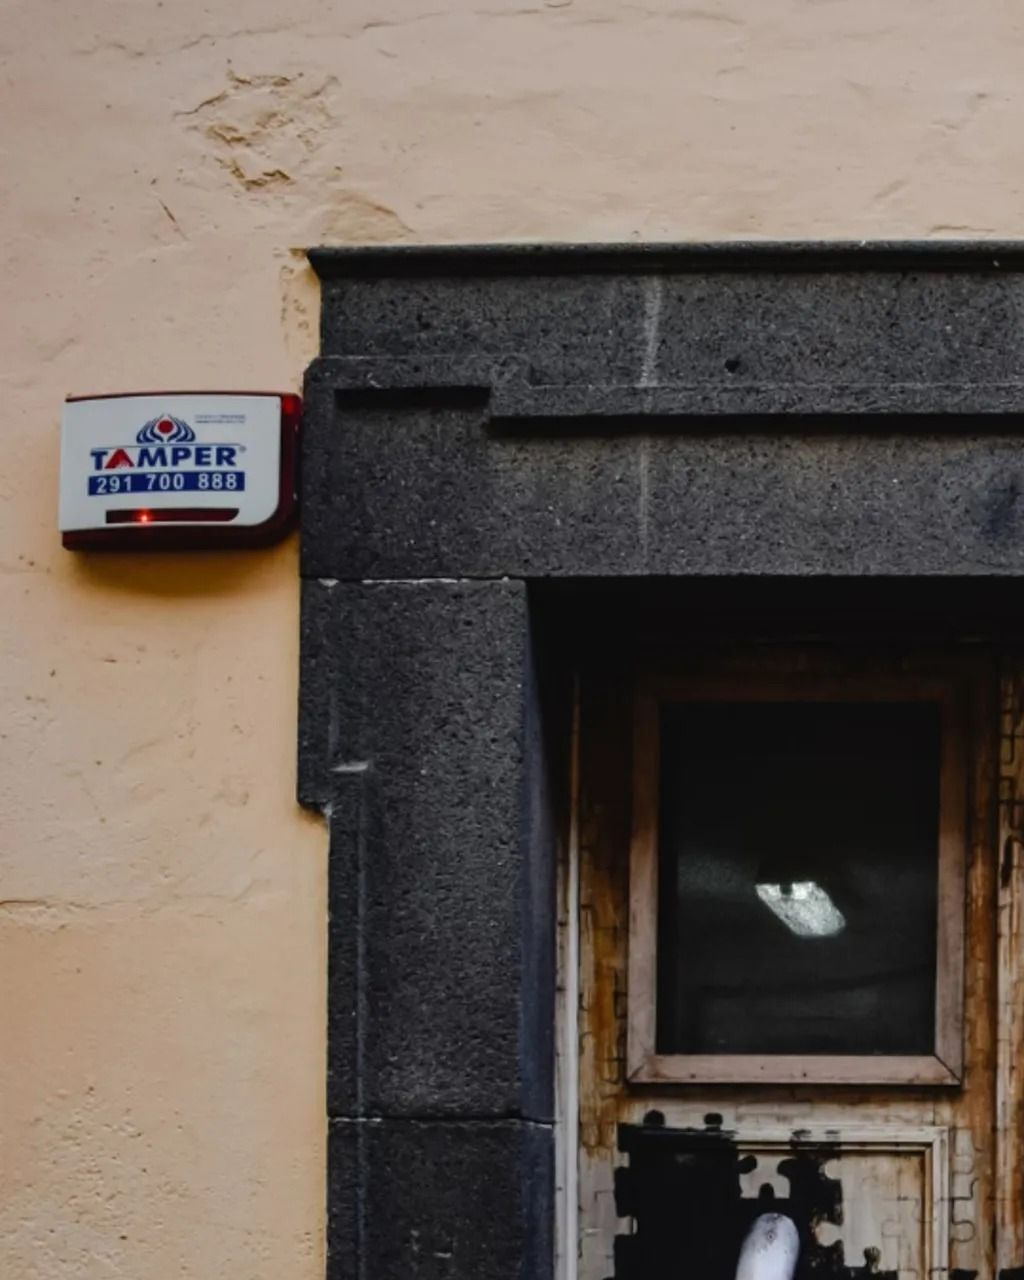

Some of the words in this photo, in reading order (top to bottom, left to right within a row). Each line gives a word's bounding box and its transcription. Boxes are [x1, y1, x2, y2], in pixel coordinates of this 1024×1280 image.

[90, 447, 236, 470] TAMPER
[97, 475, 132, 493] 291
[147, 473, 184, 490] 700
[198, 473, 237, 489] 888
